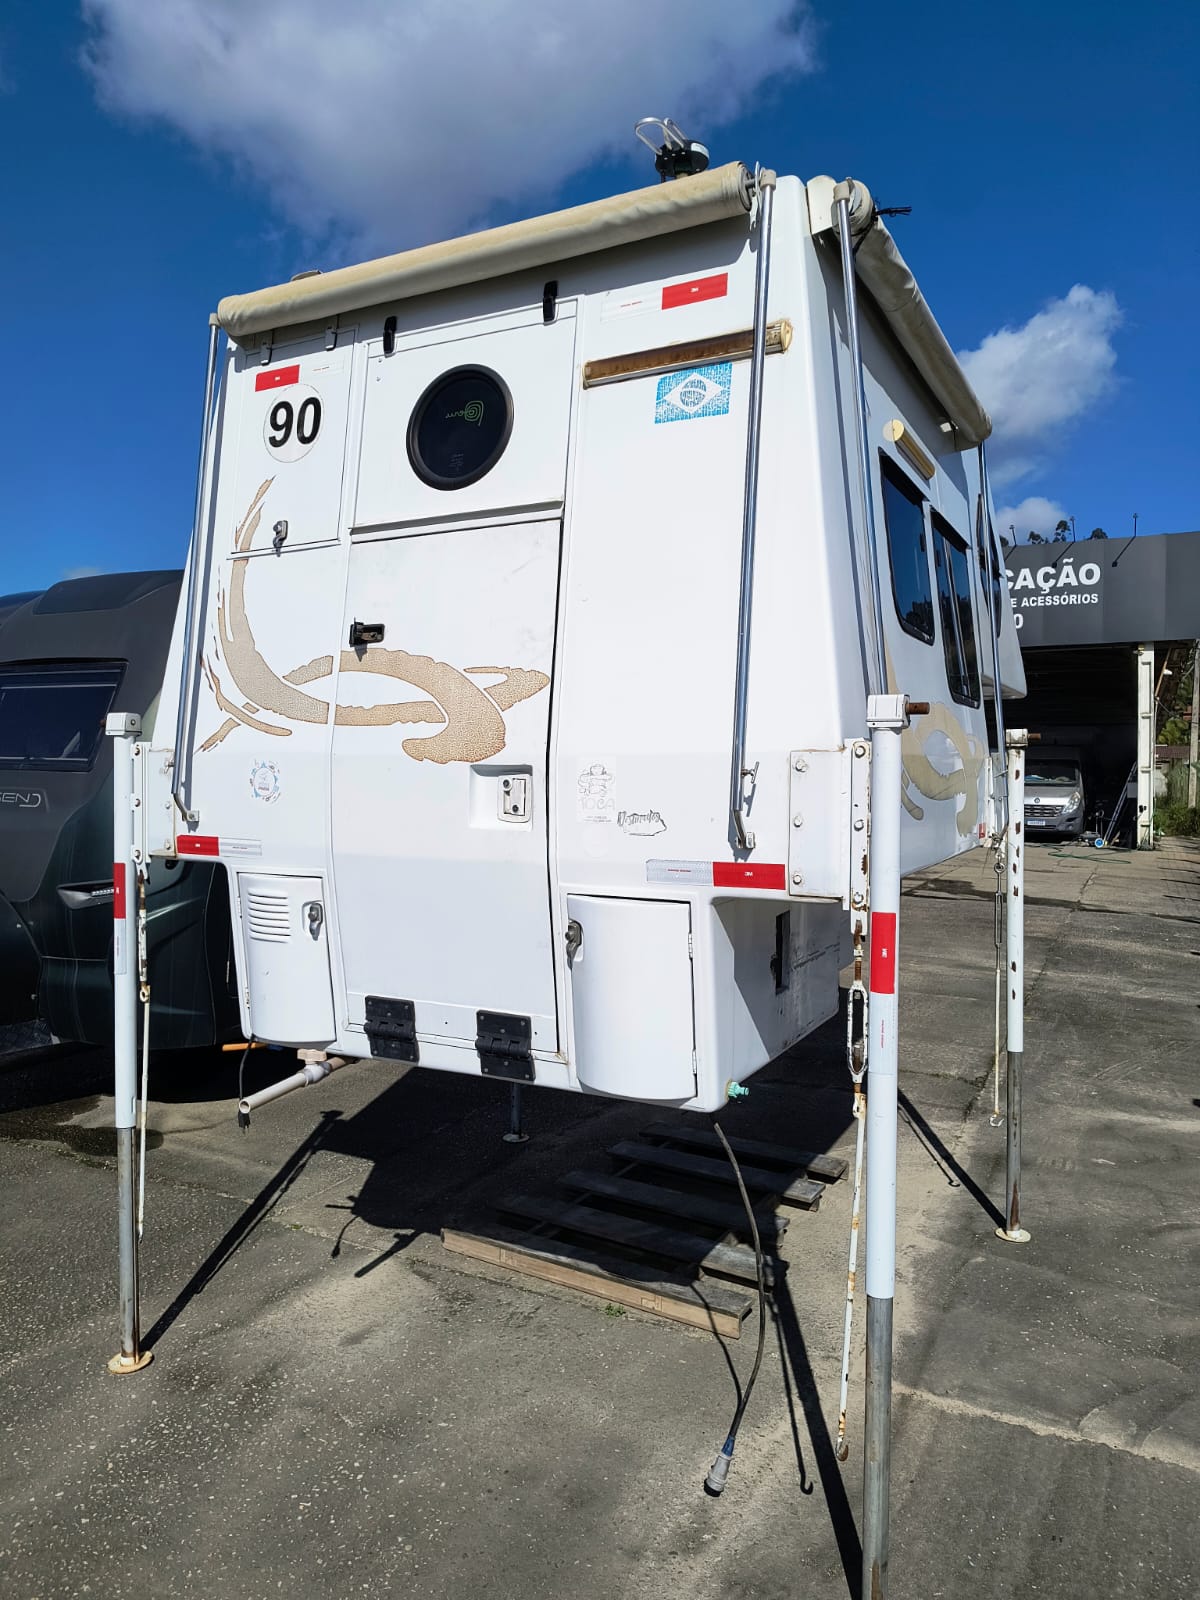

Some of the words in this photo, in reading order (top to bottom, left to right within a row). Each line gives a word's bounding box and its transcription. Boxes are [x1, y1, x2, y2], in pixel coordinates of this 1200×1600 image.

[269, 397, 321, 448] 90
[1021, 592, 1099, 607] ACESSÓRIOS
[0, 792, 41, 808] END
